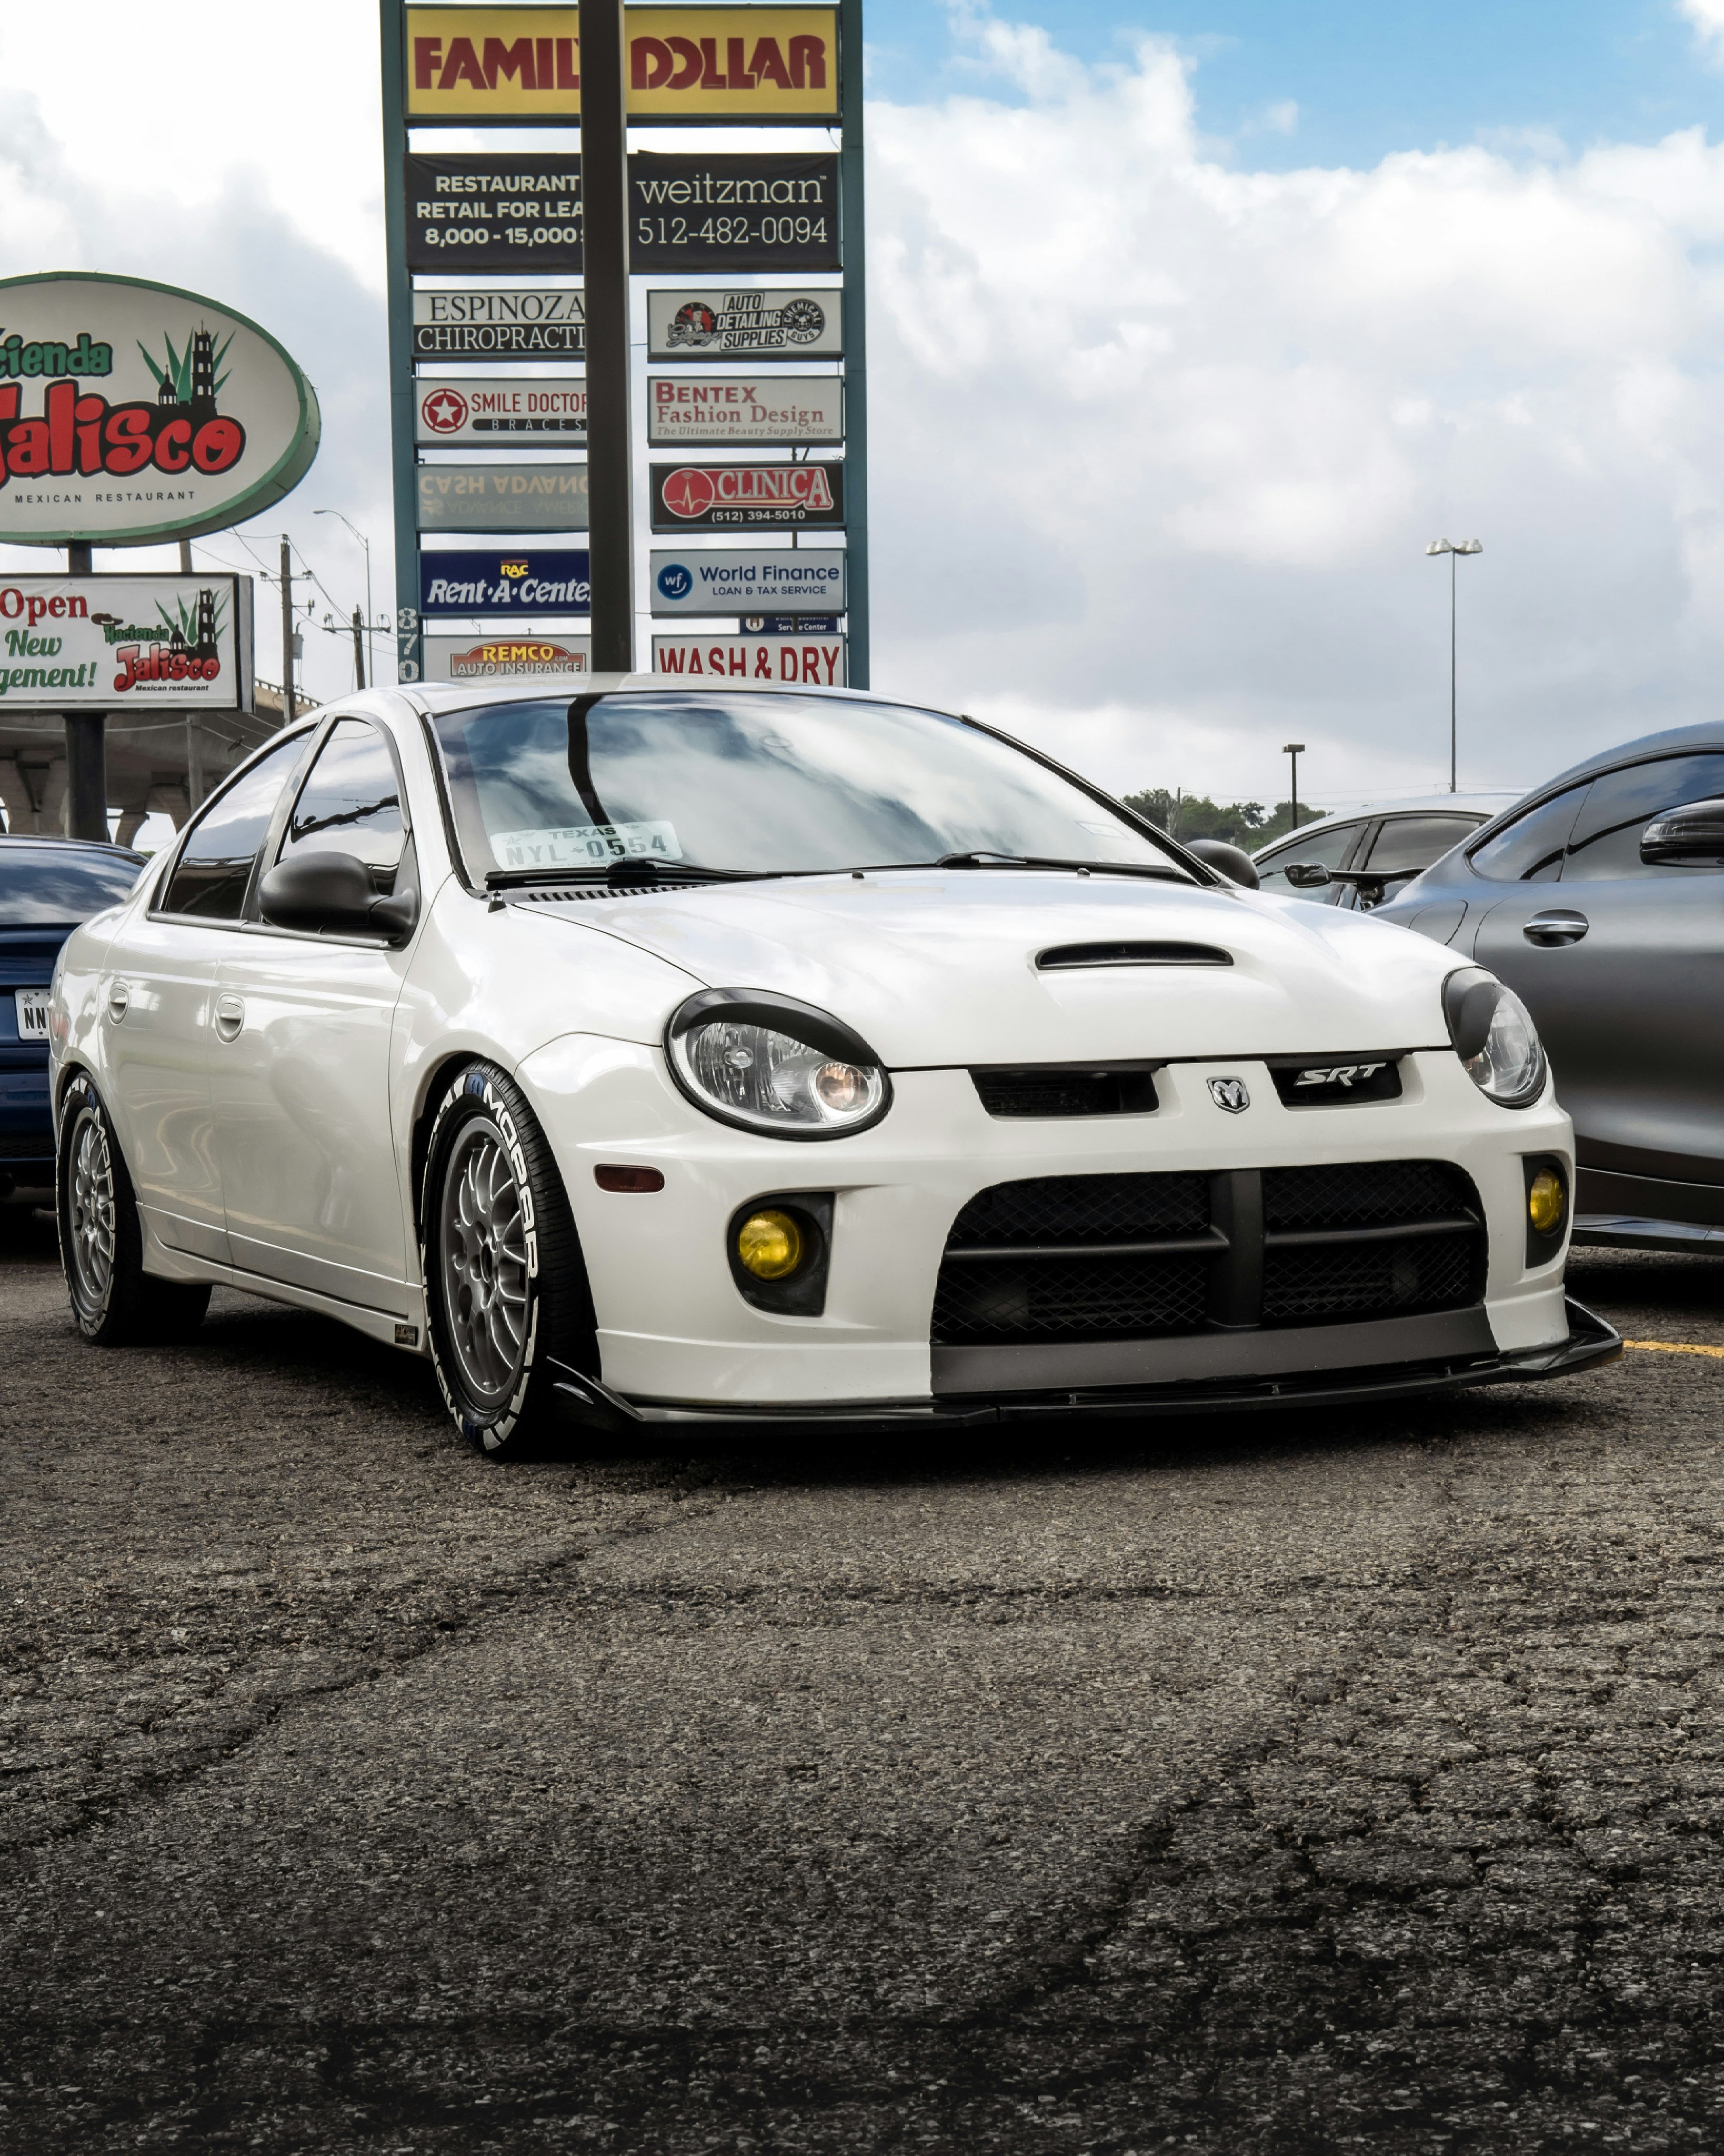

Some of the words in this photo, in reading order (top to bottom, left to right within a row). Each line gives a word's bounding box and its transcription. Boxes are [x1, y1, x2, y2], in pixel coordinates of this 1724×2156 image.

[414, 37, 580, 89] FAMIL
[630, 35, 827, 90] DOLLAR
[436, 175, 580, 192] RESTAURANT
[417, 202, 492, 218] RETAIL
[497, 202, 539, 217] FOR
[425, 228, 488, 247] 8,000
[505, 227, 577, 246] 15,000
[638, 217, 827, 244] 512-482-0094
[429, 295, 585, 321] ESPINOZA
[727, 294, 761, 311] AUTO
[716, 311, 781, 330] DETAILING
[784, 302, 820, 323] CHEMICAL
[724, 329, 785, 348] SUPPLIES
[791, 331, 815, 341] GUYS
[471, 393, 521, 412] SMILE
[492, 420, 582, 431] BRACES
[657, 405, 741, 423] Fashion
[750, 405, 824, 427] Design
[0, 378, 246, 490] alisco
[657, 427, 676, 435] The
[679, 426, 726, 435] Ultimate
[728, 426, 765, 436] Beauty
[767, 426, 804, 436] Supply
[806, 426, 833, 435] Store
[15, 495, 82, 503] MEXICAN
[96, 491, 195, 502] RESTAURANT
[717, 470, 830, 506] CLINICA
[711, 512, 743, 522] (512)
[748, 511, 806, 520] 394-5010
[501, 564, 528, 578] RAC
[700, 566, 756, 581] World
[763, 565, 839, 581] Finance
[665, 574, 682, 588] wf
[713, 587, 741, 595] LOAN
[757, 586, 777, 595] TAX
[781, 586, 826, 595] SERVICE
[0, 588, 88, 626] Open
[5, 630, 62, 657] New
[482, 646, 554, 663] REMCO
[114, 642, 220, 692] Jalisco
[457, 663, 496, 676] AUTO
[500, 662, 581, 675] INSURANCE
[659, 647, 746, 677] WASH
[754, 646, 772, 679] &
[780, 646, 840, 685] DRY
[548, 828, 617, 840] TEXAS
[24, 1007, 49, 1030] NN
[1294, 1062, 1387, 1087] SRT
